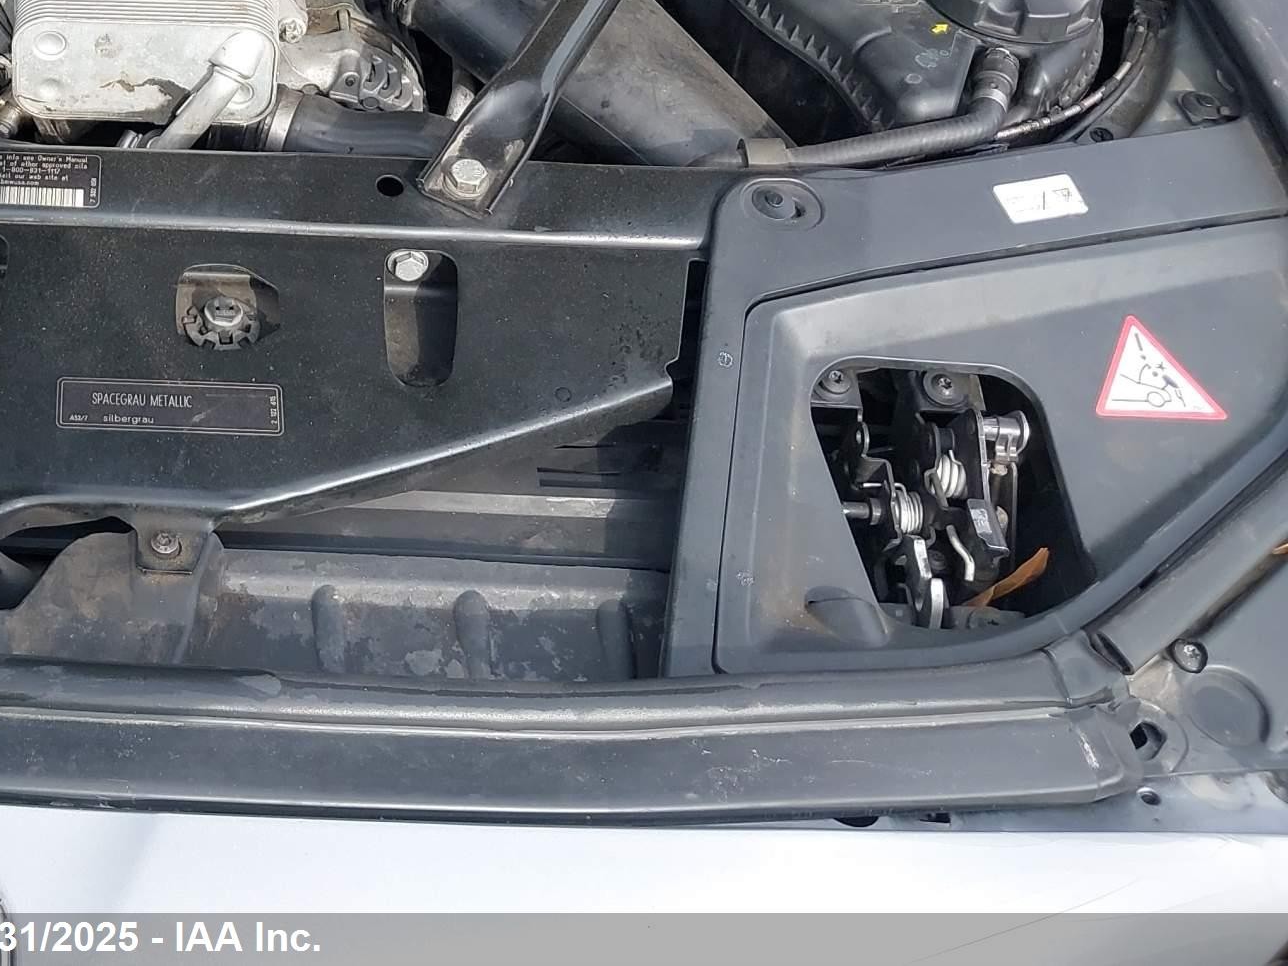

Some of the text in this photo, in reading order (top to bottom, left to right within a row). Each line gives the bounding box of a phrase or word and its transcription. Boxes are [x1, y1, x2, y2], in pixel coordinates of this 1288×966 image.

[20, 160, 39, 168] other
[42, 162, 71, 170] approved
[91, 392, 193, 408] SPACEGRAU METALLIC
[103, 413, 154, 425] silbergrau
